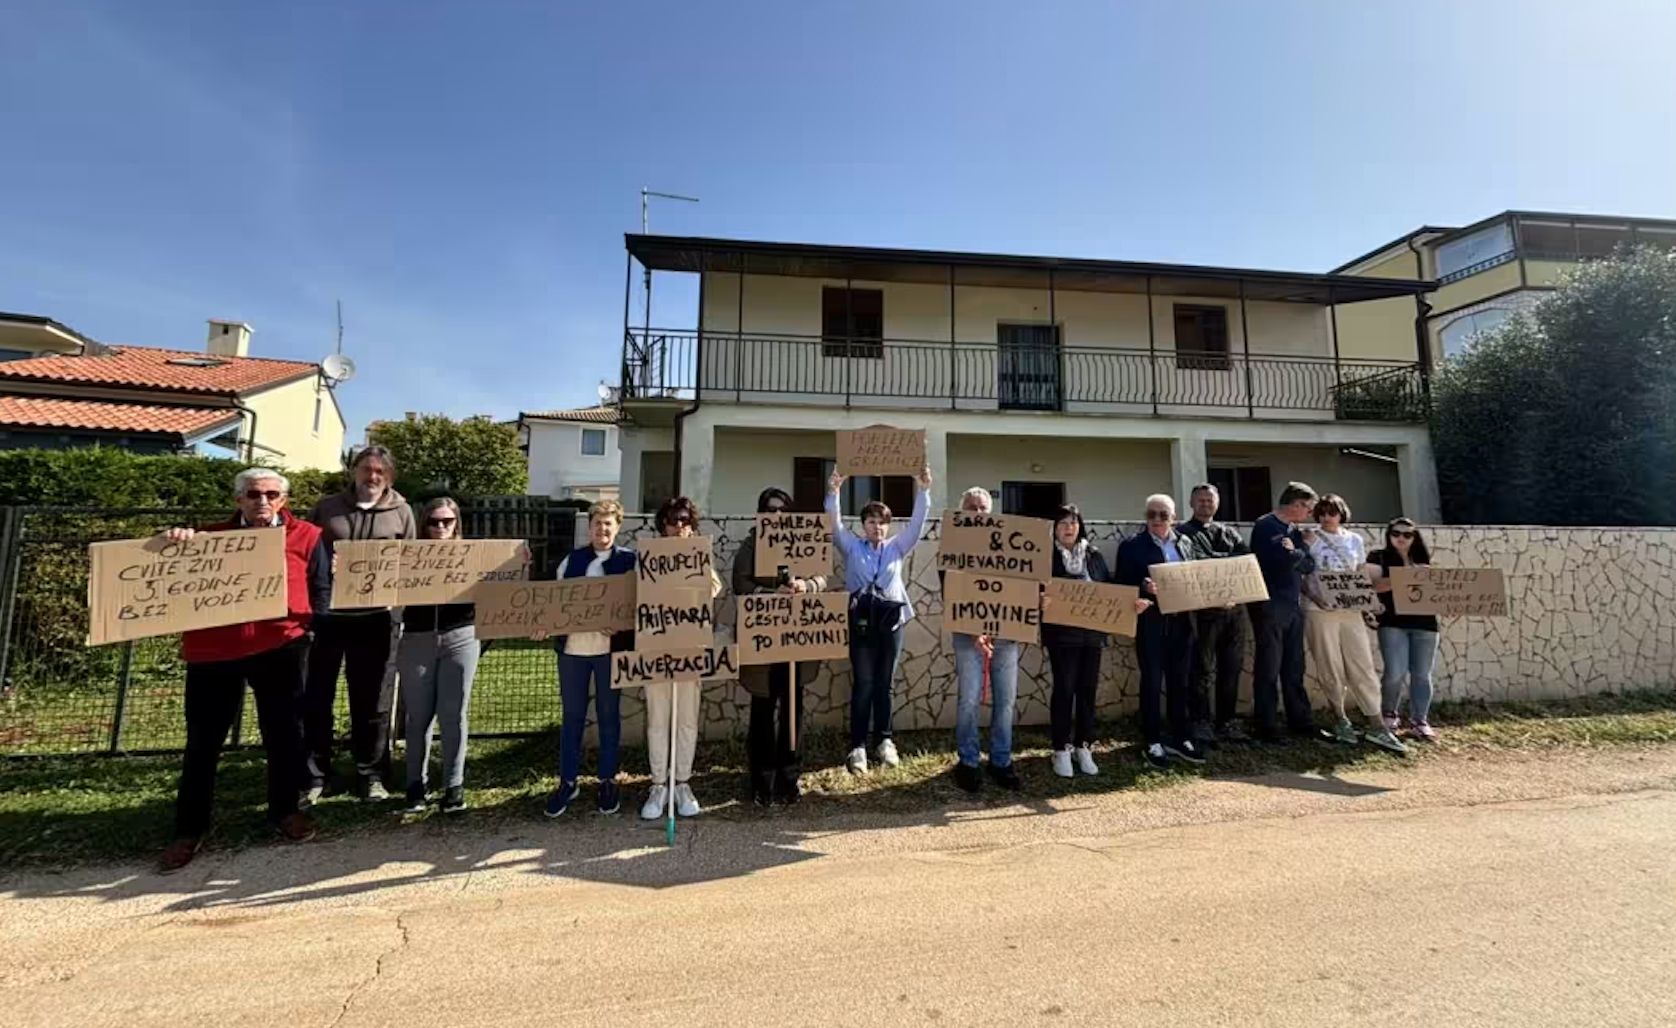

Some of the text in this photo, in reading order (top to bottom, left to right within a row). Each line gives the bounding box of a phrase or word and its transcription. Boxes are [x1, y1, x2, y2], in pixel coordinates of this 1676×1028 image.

[760, 516, 824, 538] POHLEPA
[158, 536, 259, 558] OBITELJ
[990, 531, 1041, 552] & Co.
[168, 572, 251, 596] GODINE
[443, 571, 467, 585] BEZ
[973, 579, 1003, 592] DO
[118, 603, 168, 620] BEZ
[193, 589, 249, 611] VODE
[510, 583, 607, 608] OBITELJ
[801, 599, 824, 613] NA
[952, 602, 1038, 626] IMOVINE
[752, 635, 772, 651] PO
[615, 646, 736, 684] MALVERZACIJA
